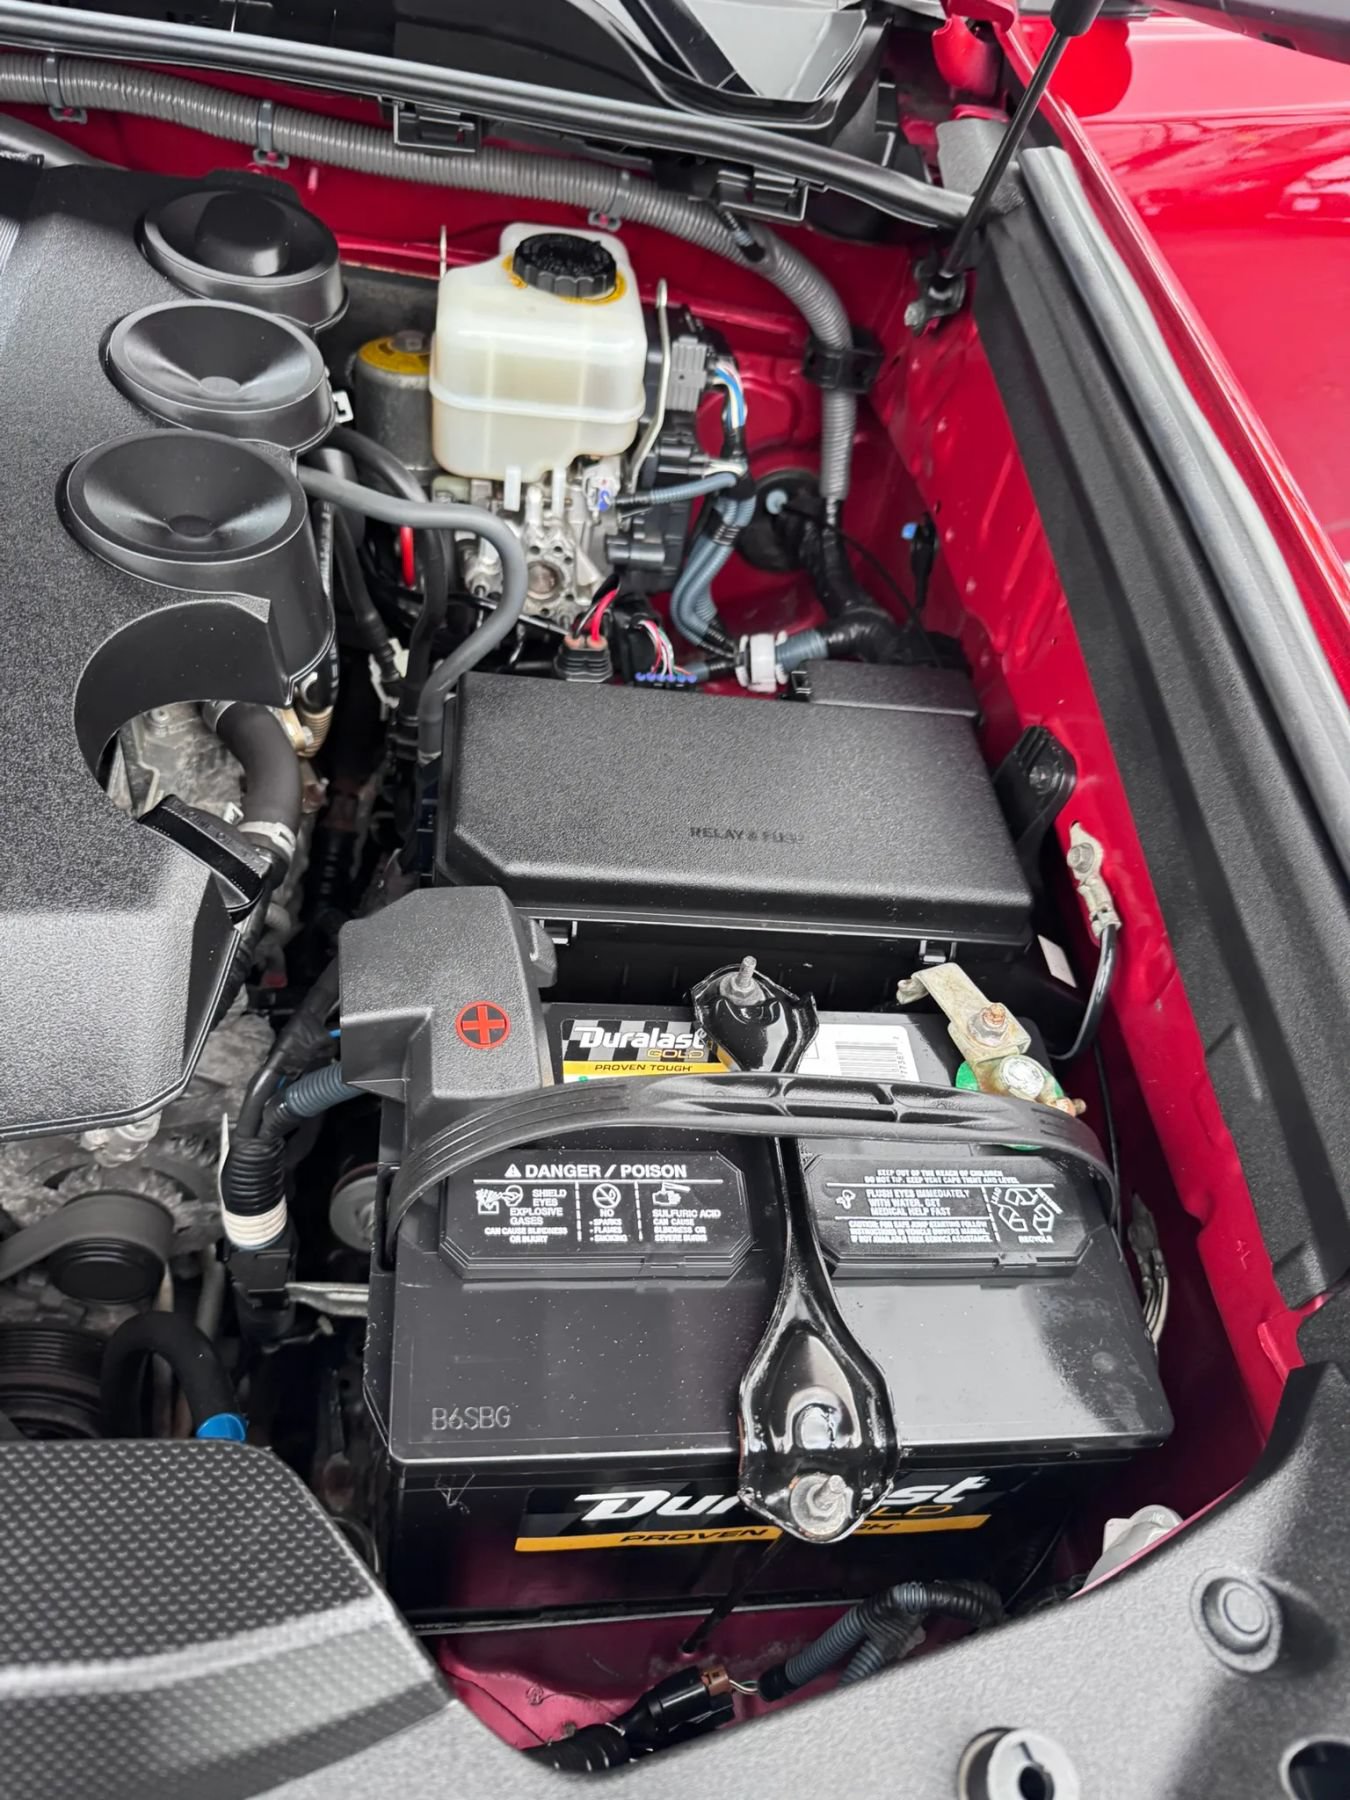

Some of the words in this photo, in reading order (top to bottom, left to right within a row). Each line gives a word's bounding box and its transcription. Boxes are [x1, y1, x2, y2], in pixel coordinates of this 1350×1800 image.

[690, 827, 744, 840] RELAY
[574, 1026, 706, 1049] Duralast
[647, 1049, 704, 1059] GOLD
[594, 1063, 646, 1072] PROVEN
[651, 1064, 691, 1073] TOUGH
[525, 1164, 601, 1178] DANGER
[604, 1164, 617, 1178] /
[620, 1164, 687, 1178] POISON
[532, 1189, 567, 1198] SHIELD
[866, 1189, 893, 1198] FLUSH
[893, 1189, 915, 1198] EYES
[915, 1189, 970, 1198] IMMEDIATELY
[532, 1198, 558, 1207] EYES
[868, 1198, 891, 1207] WITH
[924, 1198, 941, 1207] GET
[509, 1207, 564, 1216] EXPLOSIVE
[600, 1209, 615, 1217] NO
[652, 1209, 698, 1218] SULFURIC
[700, 1209, 721, 1219] ACID
[870, 1207, 908, 1216] MEDICAL
[908, 1207, 930, 1216] HELP
[930, 1207, 951, 1216] FAST
[509, 1217, 544, 1226] GASES
[653, 1218, 669, 1226] CAN
[670, 1219, 695, 1227] CAUSE
[484, 1227, 501, 1235] CAN
[501, 1227, 527, 1235] CAUSE
[694, 1226, 706, 1234] OR
[432, 1406, 511, 1431] B6SBG
[574, 1476, 990, 1521] Durst
[620, 1528, 768, 1543] PROVEN
